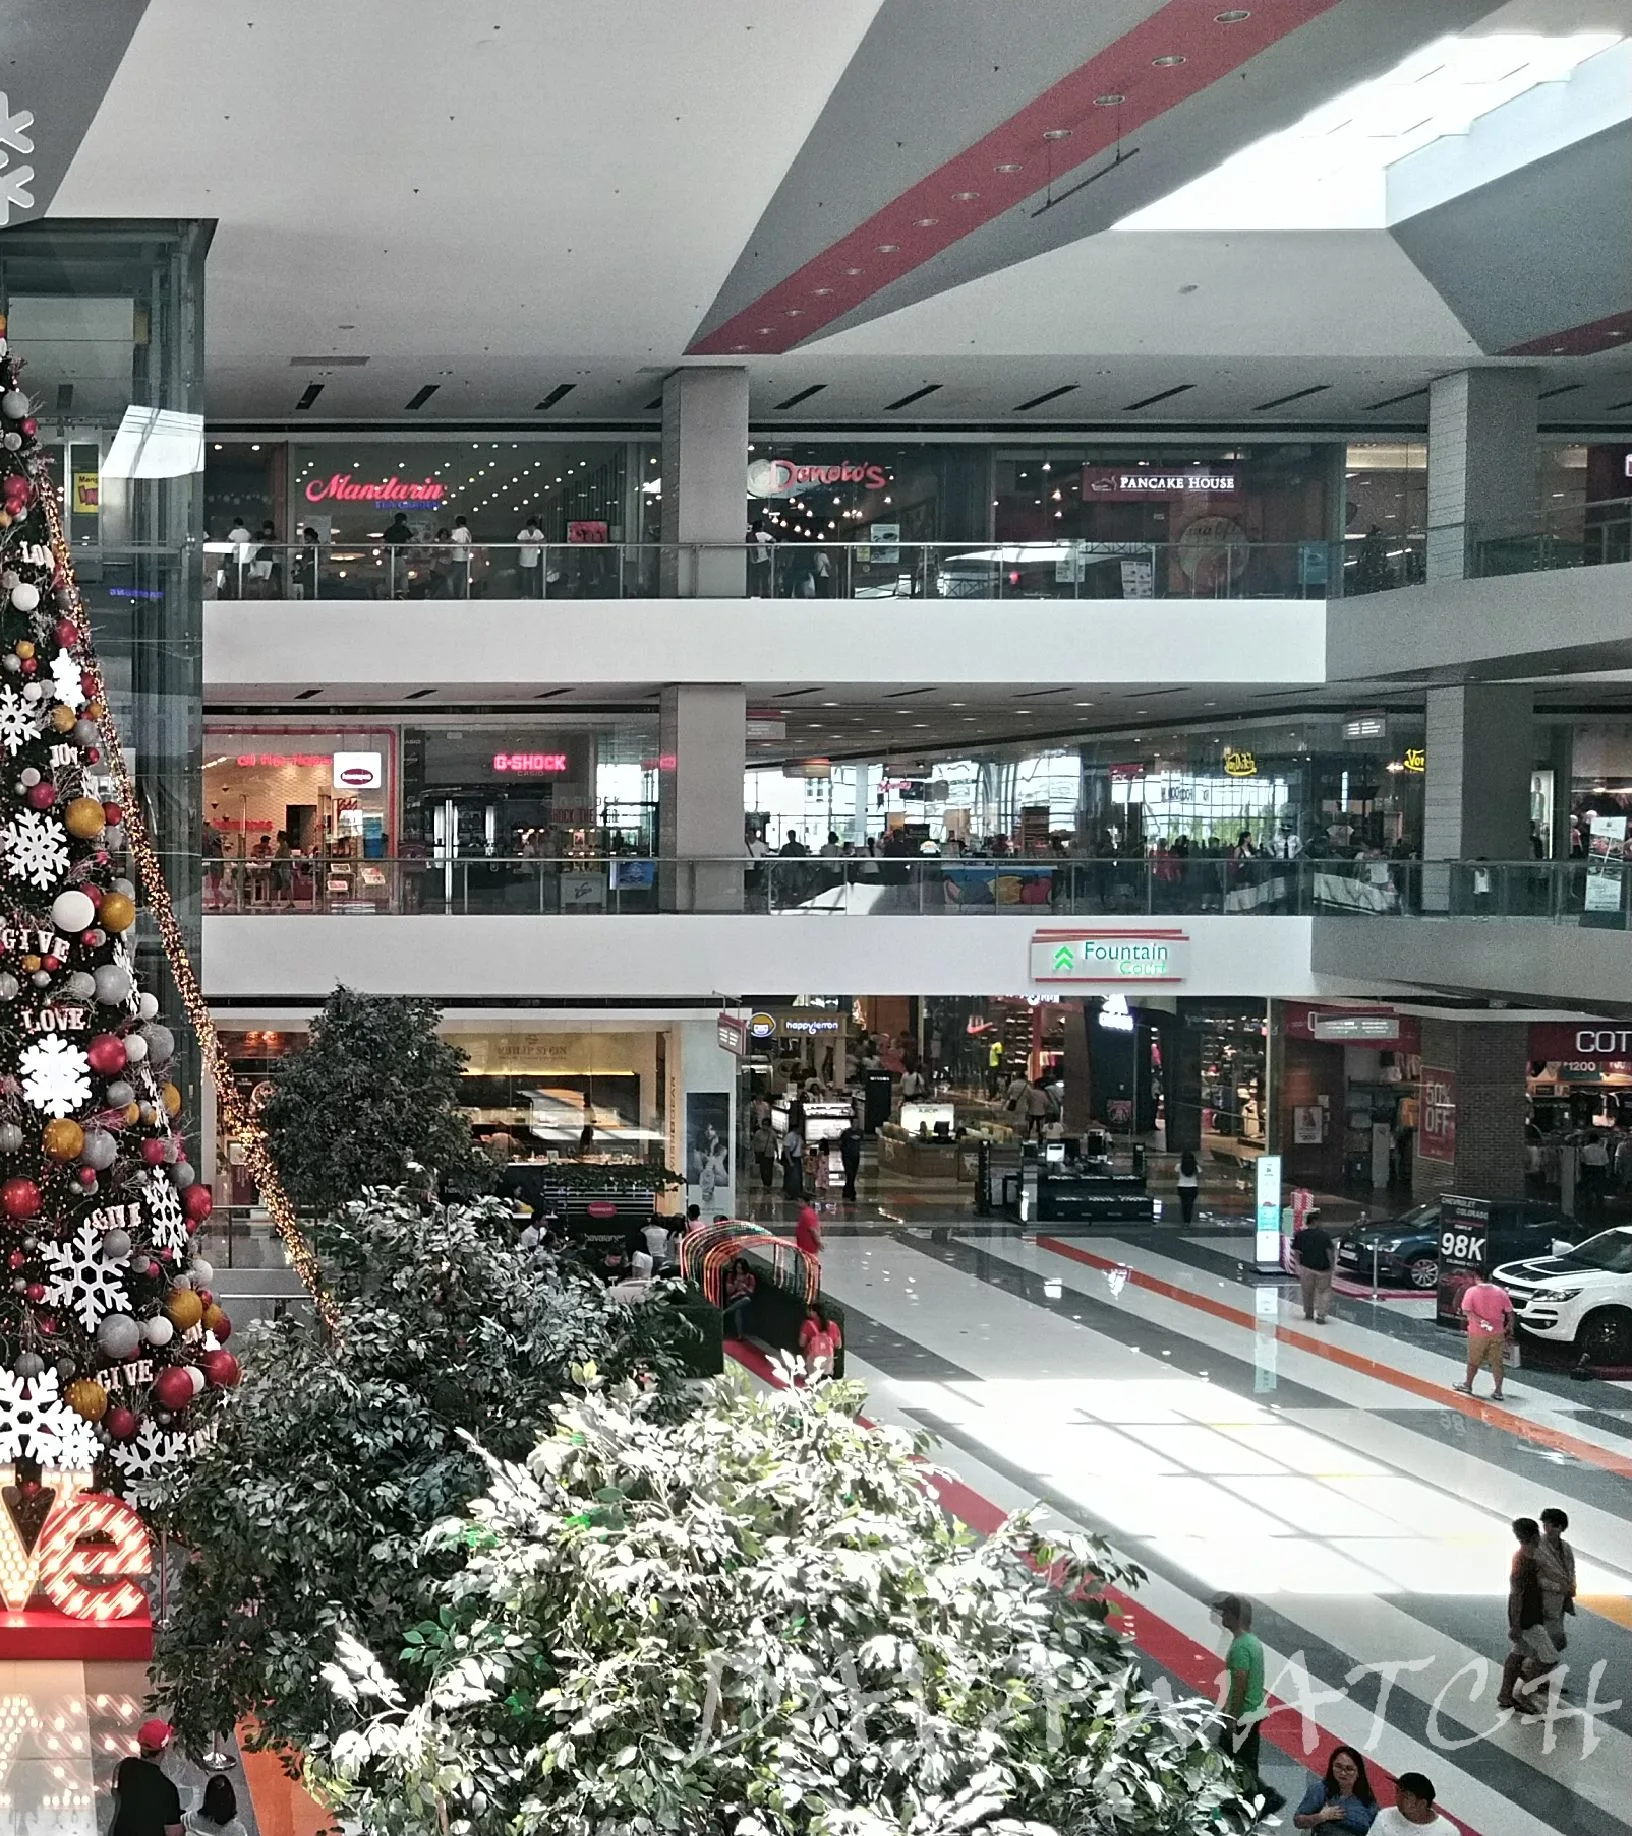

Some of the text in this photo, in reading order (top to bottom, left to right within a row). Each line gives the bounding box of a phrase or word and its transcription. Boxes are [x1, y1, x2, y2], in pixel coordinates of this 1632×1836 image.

[305, 473, 443, 502] Mandarin
[1120, 476, 1235, 490] PANCAKE HOUSE
[493, 755, 567, 771] G-SHOCK
[2, 928, 71, 963] GIVE
[1084, 941, 1169, 961] Fountain
[21, 1007, 87, 1033] LOVE
[1425, 1107, 1451, 1135] OFF
[1441, 1232, 1486, 1261] 98K
[96, 1359, 154, 1390] GIVE
